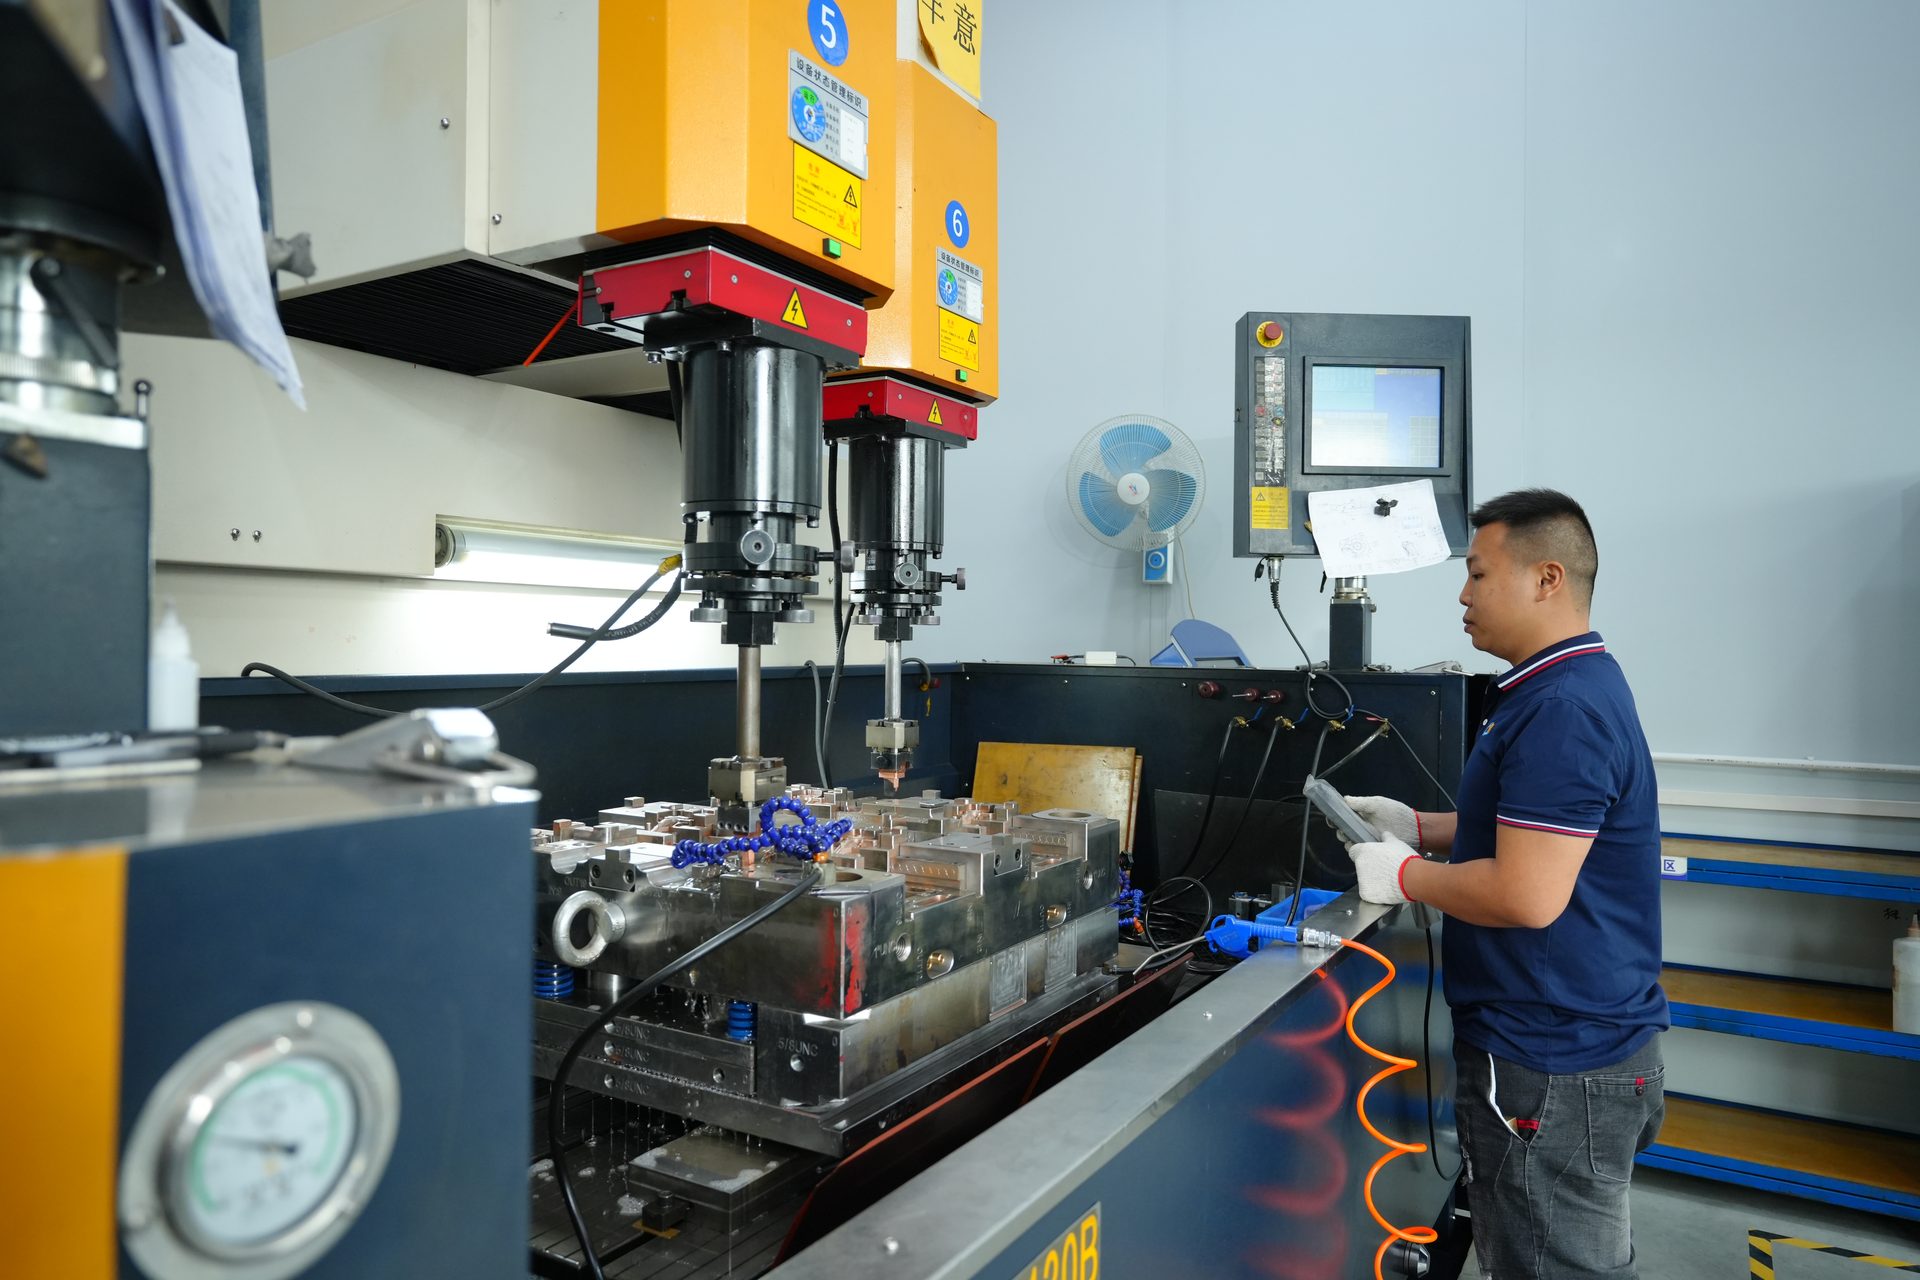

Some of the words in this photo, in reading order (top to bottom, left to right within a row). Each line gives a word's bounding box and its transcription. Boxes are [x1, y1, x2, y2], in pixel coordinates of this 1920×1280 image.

[820, 4, 837, 49] 5
[796, 56, 862, 109] 设备状态管理标识
[952, 208, 963, 238] 6
[777, 1037, 819, 1057] 5/8UNC
